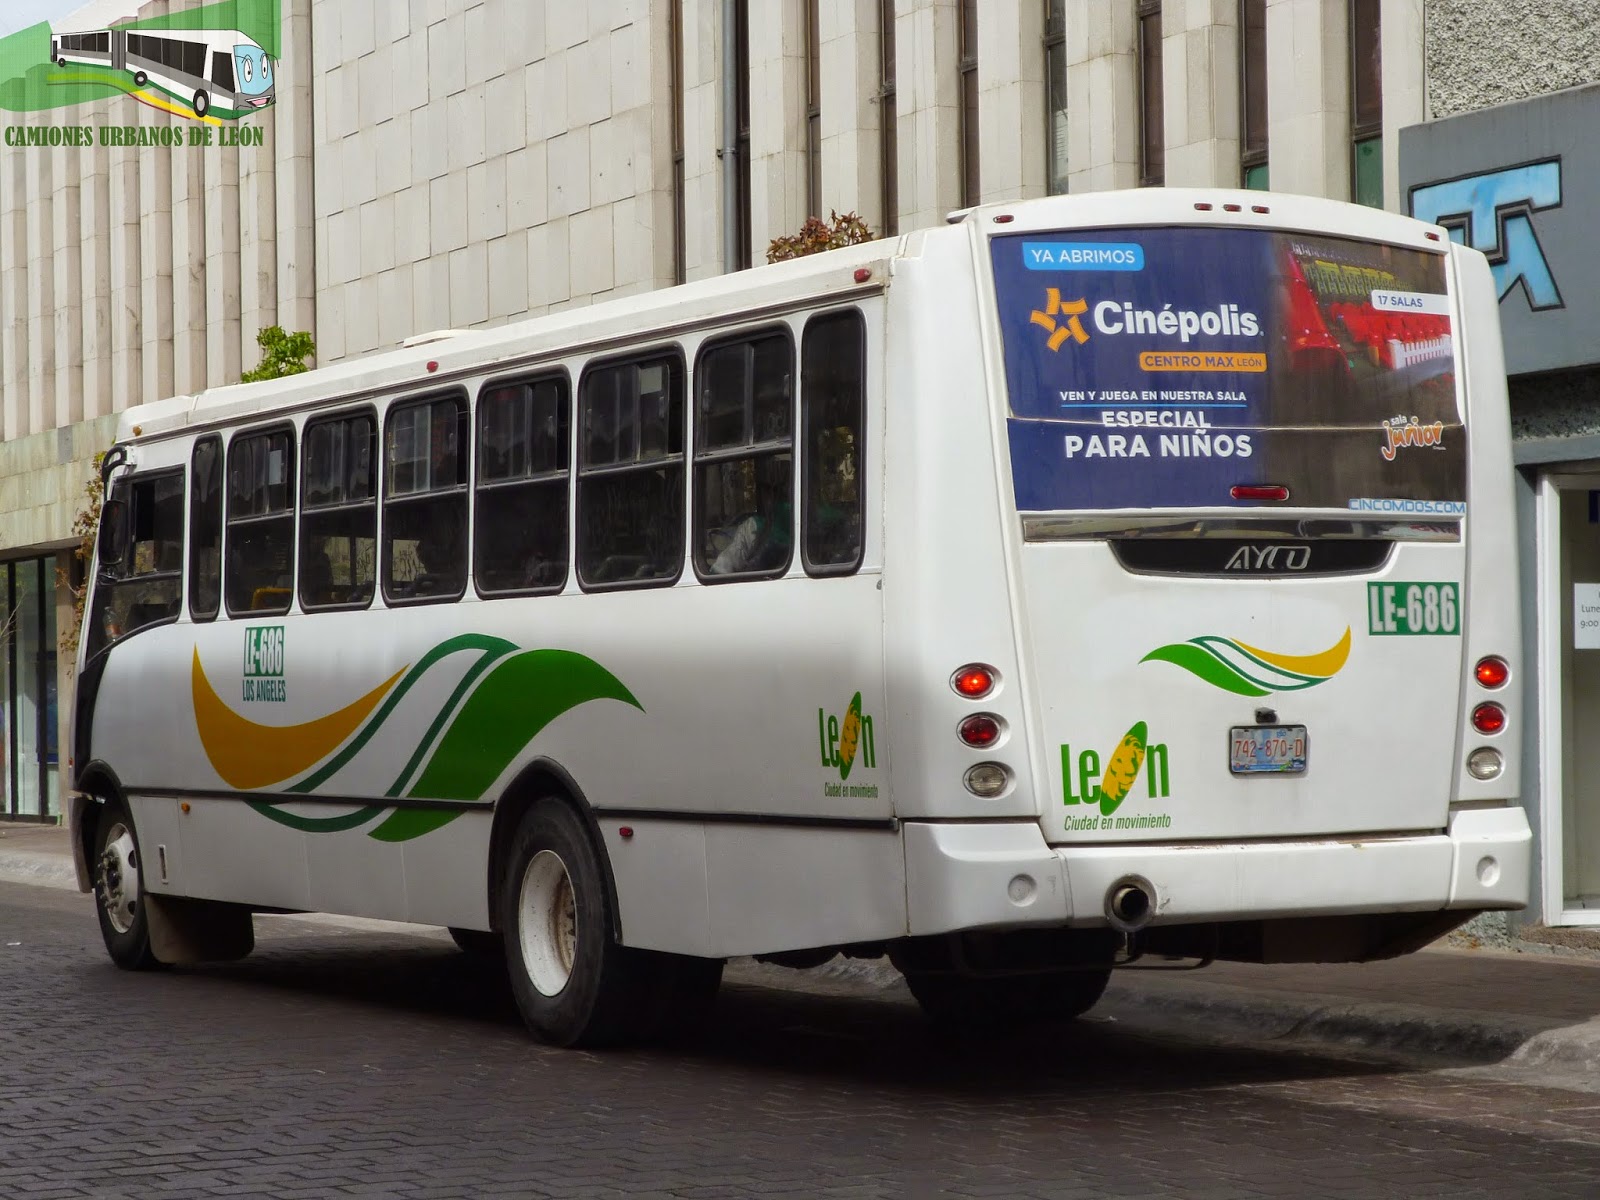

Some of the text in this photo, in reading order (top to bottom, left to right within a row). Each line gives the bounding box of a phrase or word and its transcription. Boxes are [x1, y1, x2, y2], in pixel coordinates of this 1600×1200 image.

[1031, 249, 1136, 264] YA ABRIMOS
[1377, 295, 1423, 308] 17 SALAS
[1093, 300, 1260, 343] Cinépolis
[1144, 355, 1262, 368] CENTRO MAX LEÓN
[1060, 391, 1247, 401] VEN Y JUEGA EN NUESTRA SALA
[1102, 411, 1211, 428] ESPECIAL
[1390, 414, 1408, 426] sala
[1065, 429, 1253, 458] PARA NIÑOS
[1349, 499, 1466, 513] CINCOMDOS.COM
[1370, 584, 1457, 633] LE-686
[1580, 620, 1599, 629] 9:00
[244, 627, 283, 675] LE-686
[242, 679, 286, 702] LOS ANGELES
[1064, 813, 1171, 831] Ciudad en movimiento
